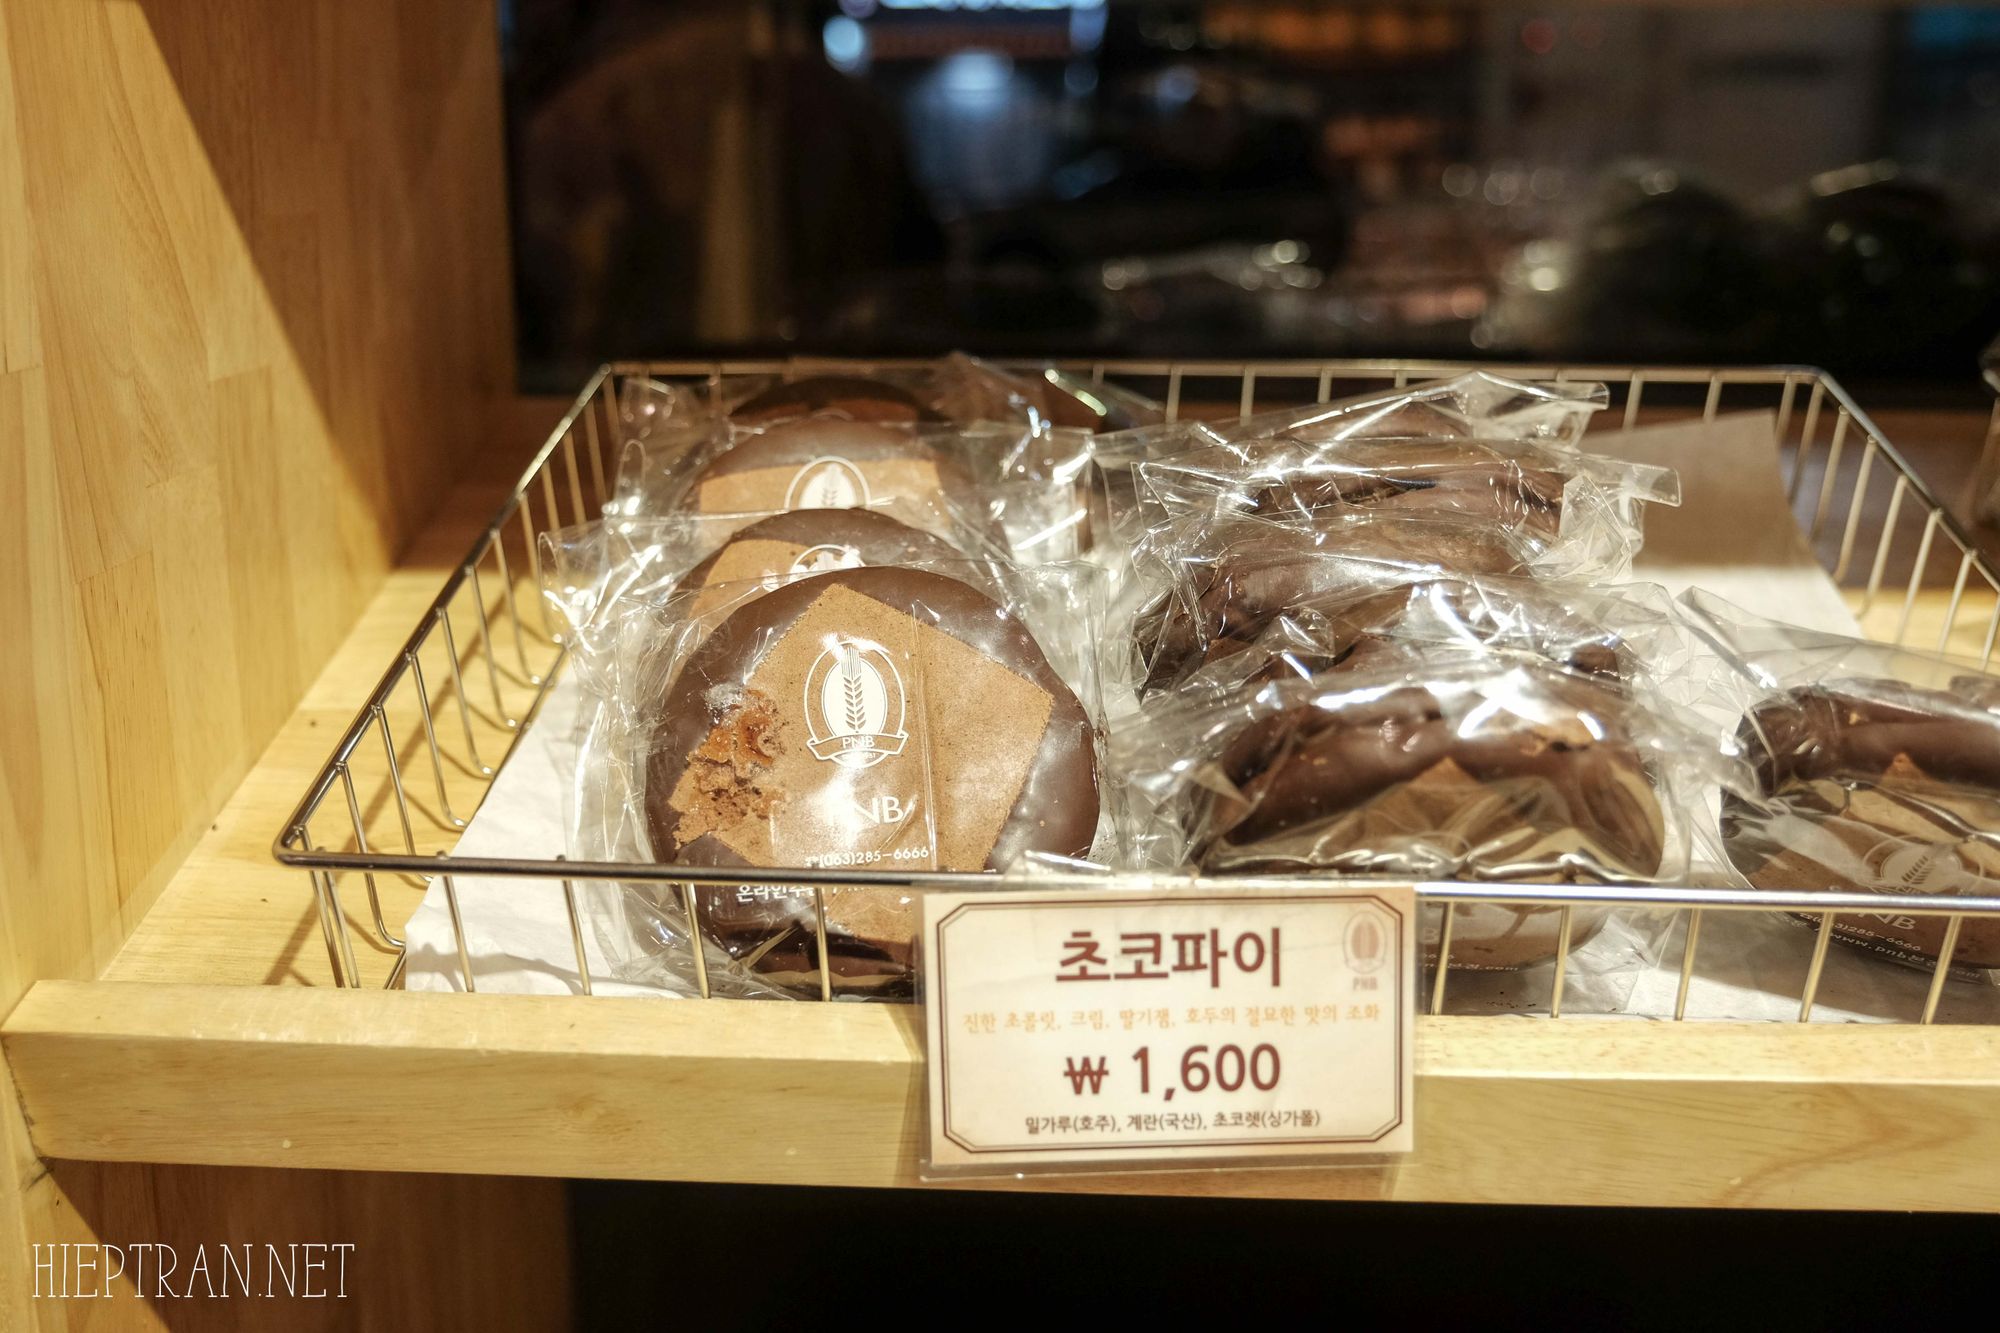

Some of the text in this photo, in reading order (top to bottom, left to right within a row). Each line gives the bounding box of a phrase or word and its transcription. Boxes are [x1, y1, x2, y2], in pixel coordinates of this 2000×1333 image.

[1858, 911, 1916, 930] NB
[1056, 927, 1281, 988] 초코파이
[963, 1013, 997, 1034] 진한
[1185, 1006, 1236, 1024] 호두의
[1246, 1005, 1295, 1027] 절묘한
[1304, 1004, 1337, 1025] 맛의
[1346, 1003, 1380, 1022] 조화
[1132, 1043, 1281, 1102] 1,600
[1025, 1109, 1321, 1135] 밀가루(호주), 계란(국산), 초코렛(싱가폴)
